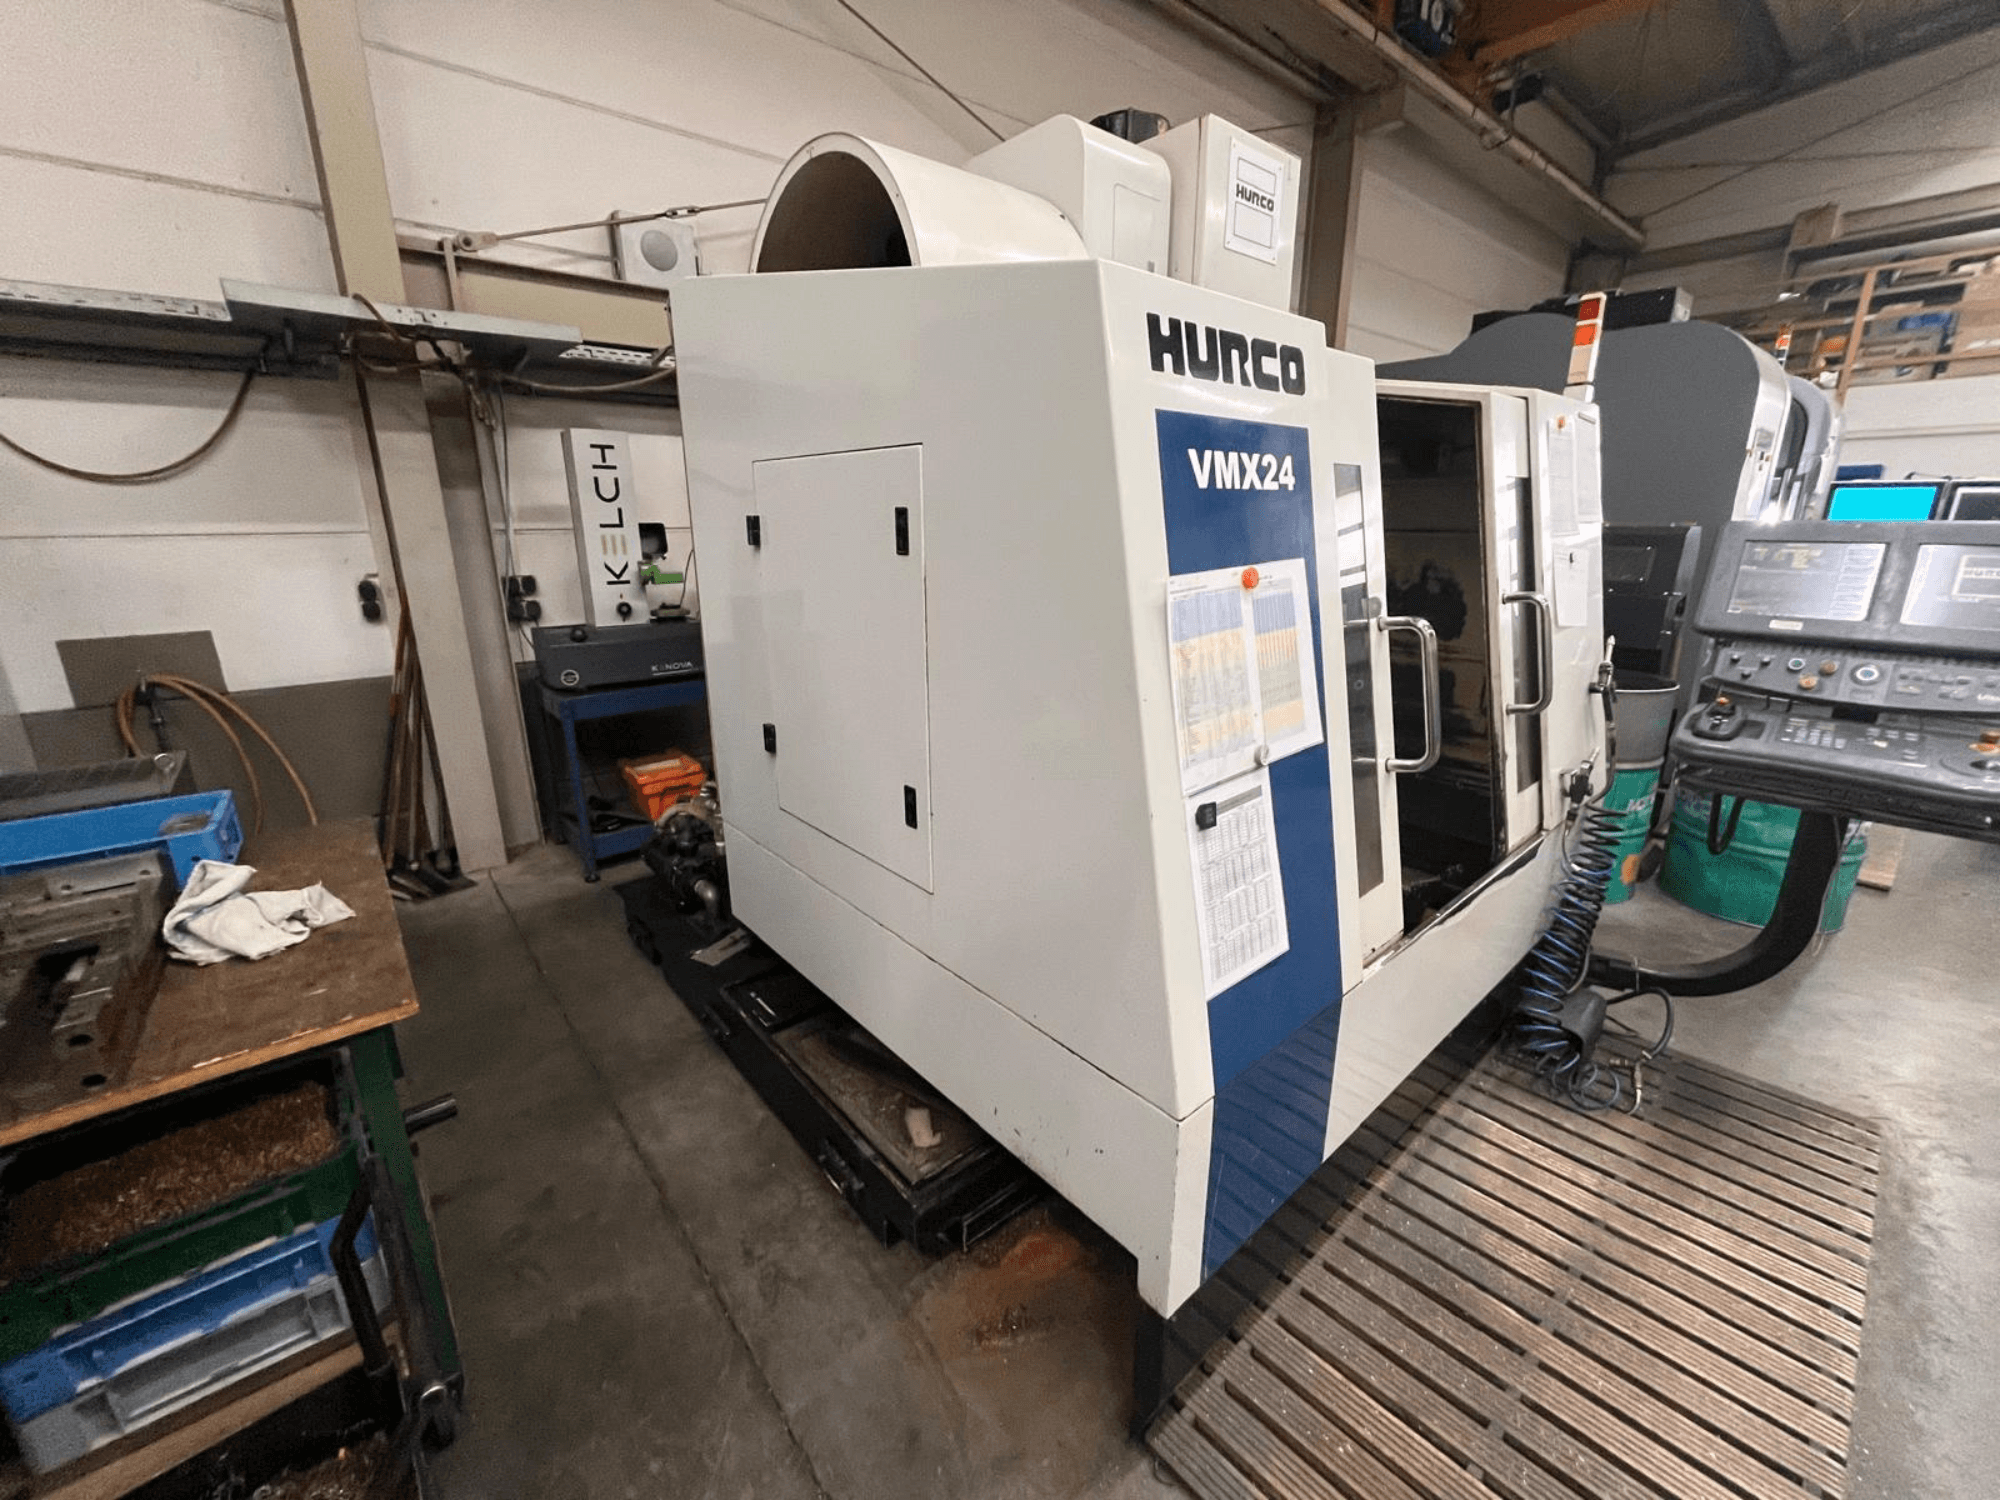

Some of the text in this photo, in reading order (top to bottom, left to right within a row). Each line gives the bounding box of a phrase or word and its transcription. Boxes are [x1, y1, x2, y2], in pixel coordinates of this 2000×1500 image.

[1236, 183, 1275, 212] HURCO
[1146, 312, 1306, 396] HURCO
[1187, 448, 1296, 491] VMX24
[590, 443, 631, 585] KELCH
